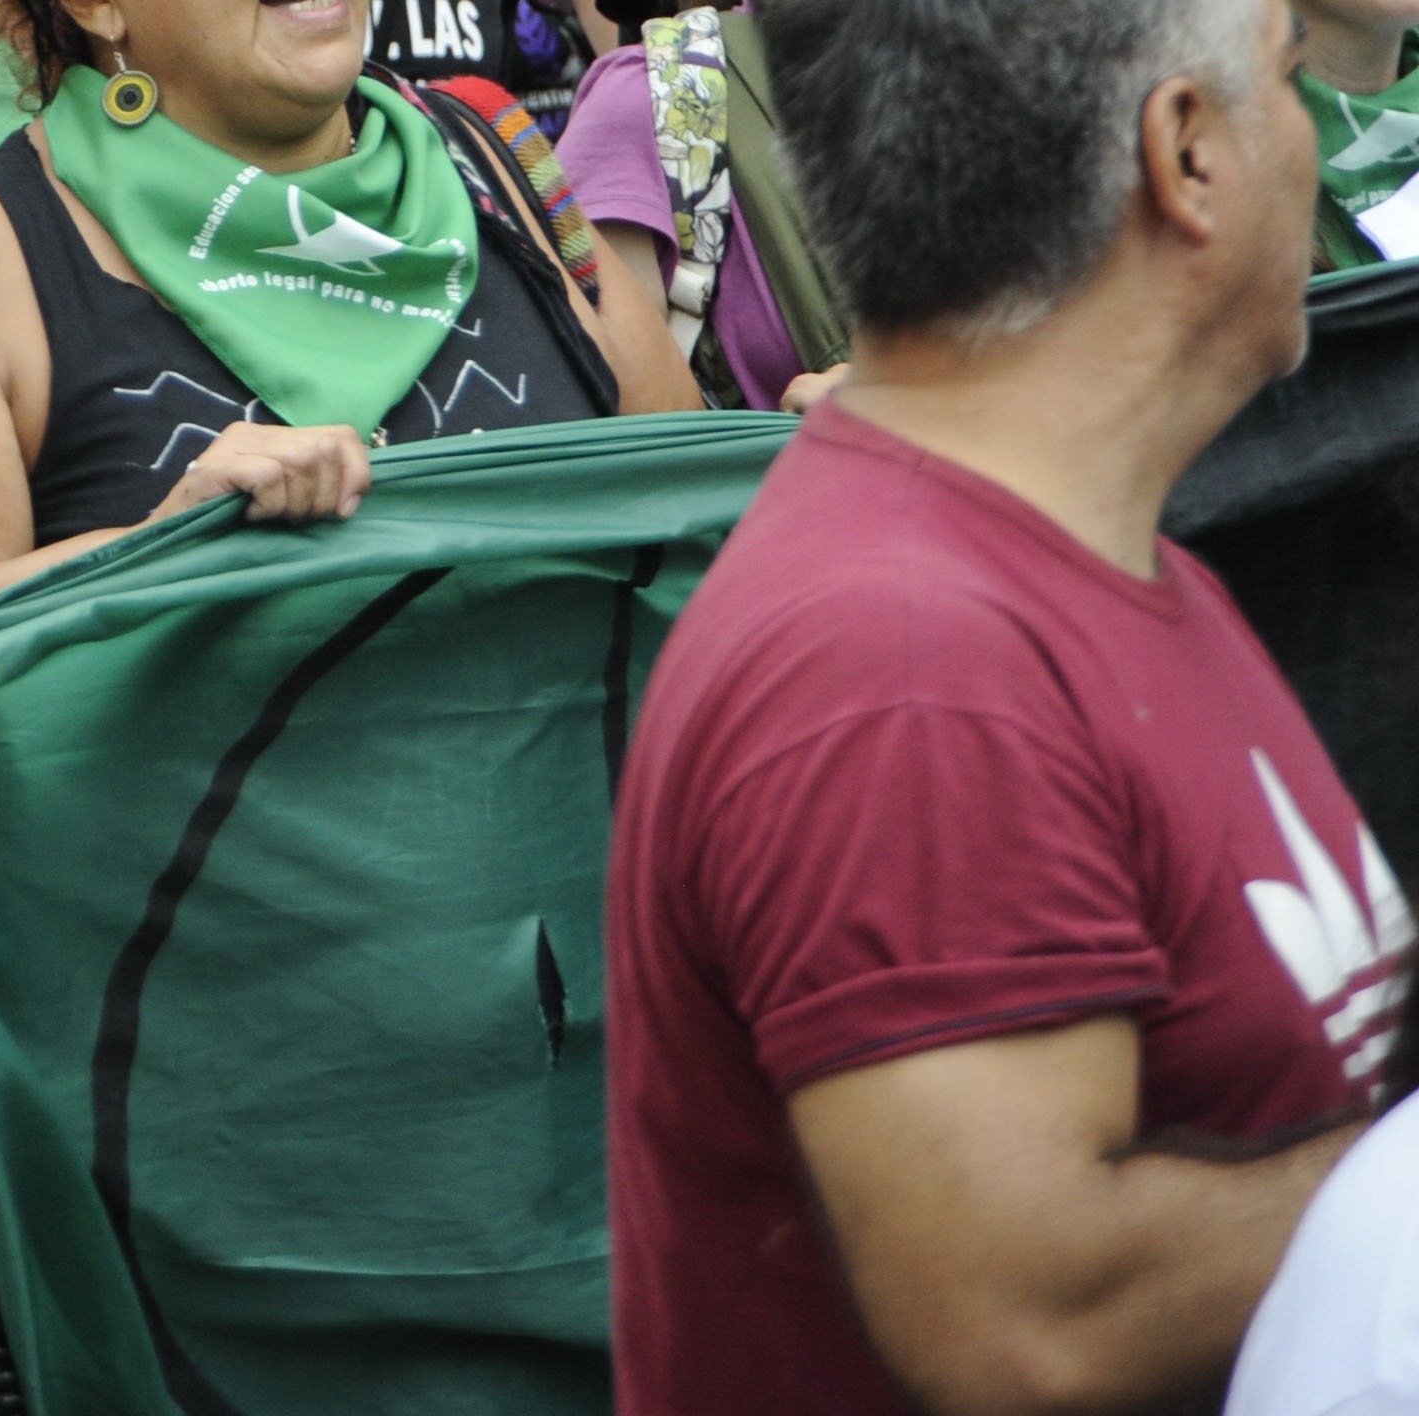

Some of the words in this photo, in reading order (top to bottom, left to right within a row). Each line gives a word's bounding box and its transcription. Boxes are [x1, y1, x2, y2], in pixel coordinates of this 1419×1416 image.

[263, 270, 316, 292] legal
[320, 280, 366, 306] para
[369, 294, 396, 314] no
